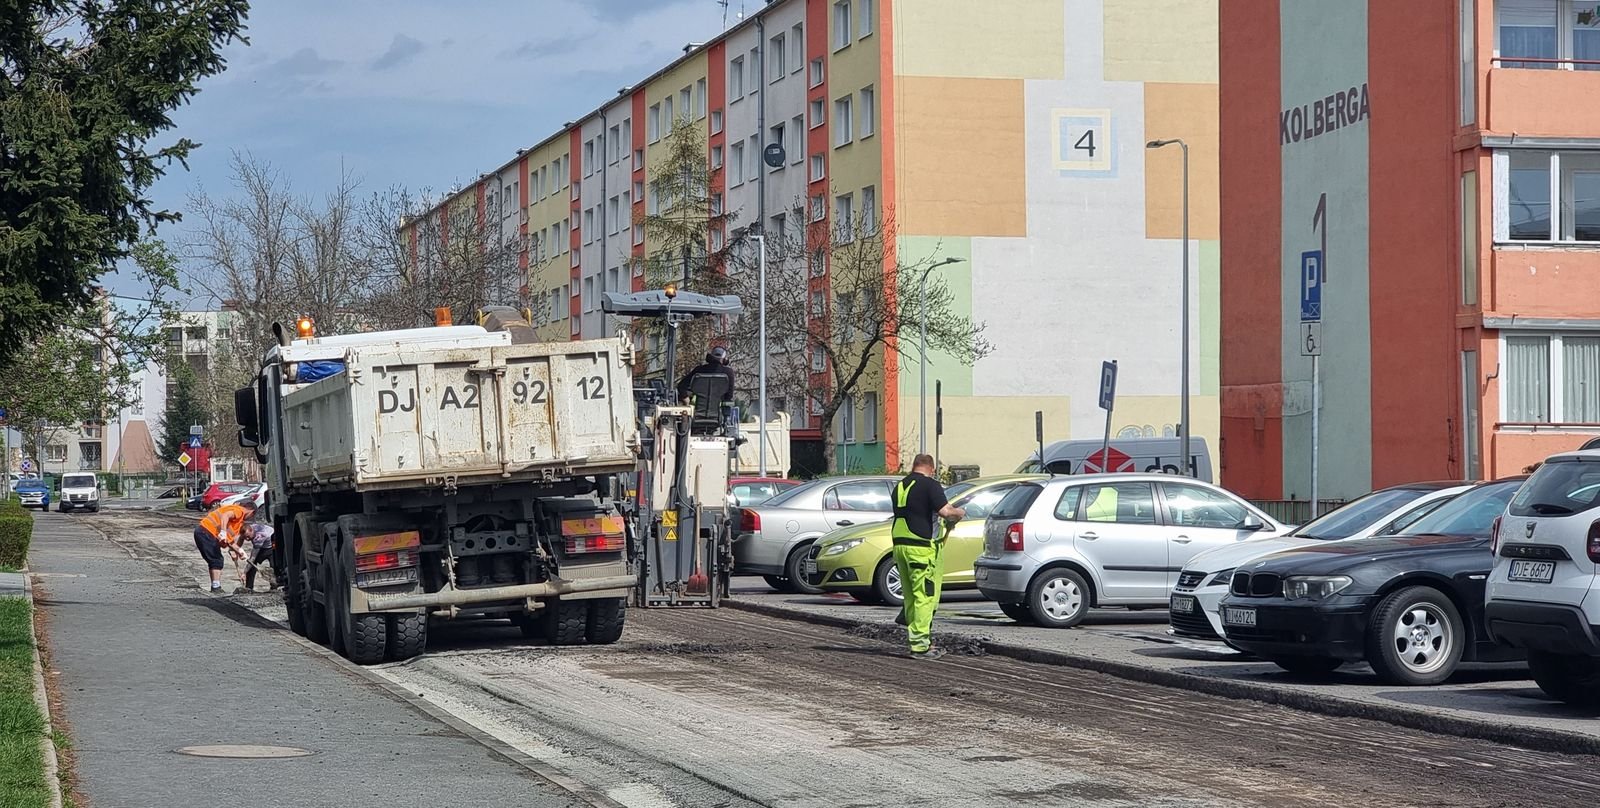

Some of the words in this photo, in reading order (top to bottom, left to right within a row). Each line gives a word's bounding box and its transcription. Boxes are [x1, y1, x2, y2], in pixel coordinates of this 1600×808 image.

[1279, 83, 1371, 146] KOLBERGA
[1074, 129, 1096, 157] 4
[1313, 193, 1327, 283] 1
[1305, 257, 1318, 300] P
[378, 388, 415, 414] DJ
[439, 384, 479, 410] A2
[512, 380, 546, 404] 92
[576, 375, 606, 400] 12
[1102, 367, 1113, 402] P
[1506, 547, 1551, 556] STER
[1513, 561, 1529, 577] DJE
[1530, 562, 1552, 578] 66P7
